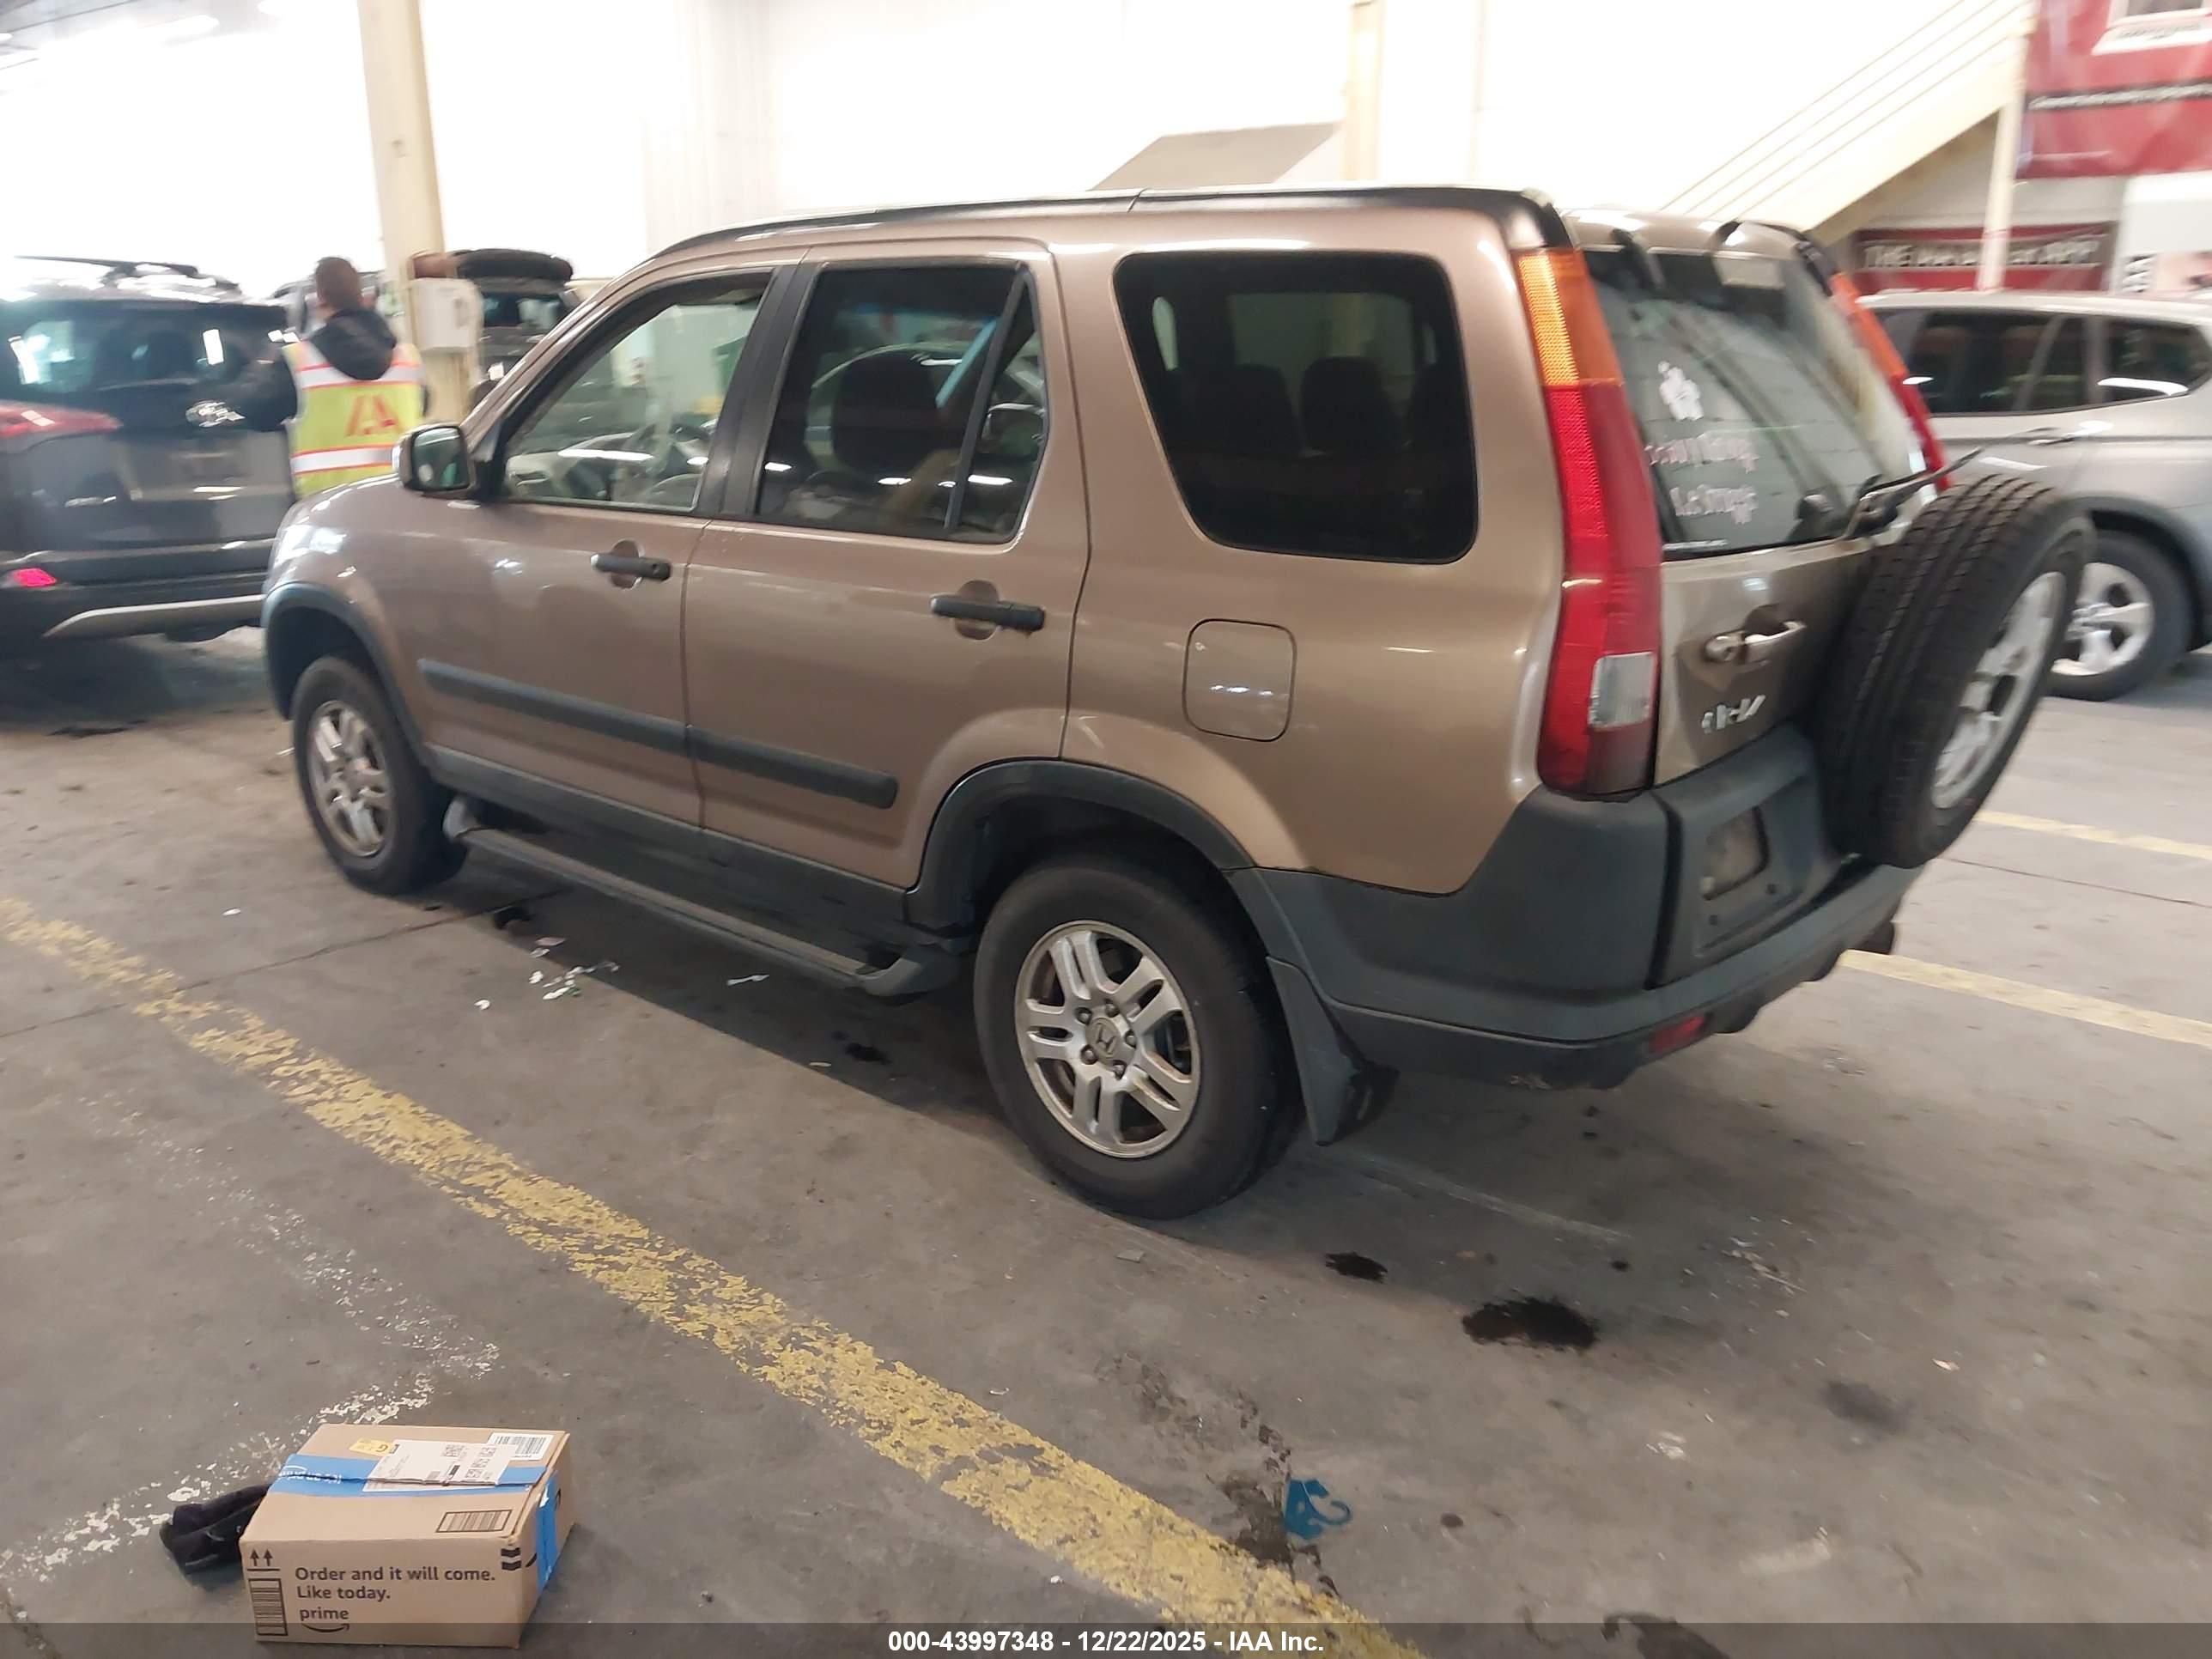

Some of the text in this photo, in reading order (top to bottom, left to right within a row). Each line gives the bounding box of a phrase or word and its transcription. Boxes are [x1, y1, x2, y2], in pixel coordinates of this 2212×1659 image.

[295, 1566, 495, 1582] Order and it will come.
[296, 1586, 391, 1602] Like today.
[300, 1607, 349, 1621] prime
